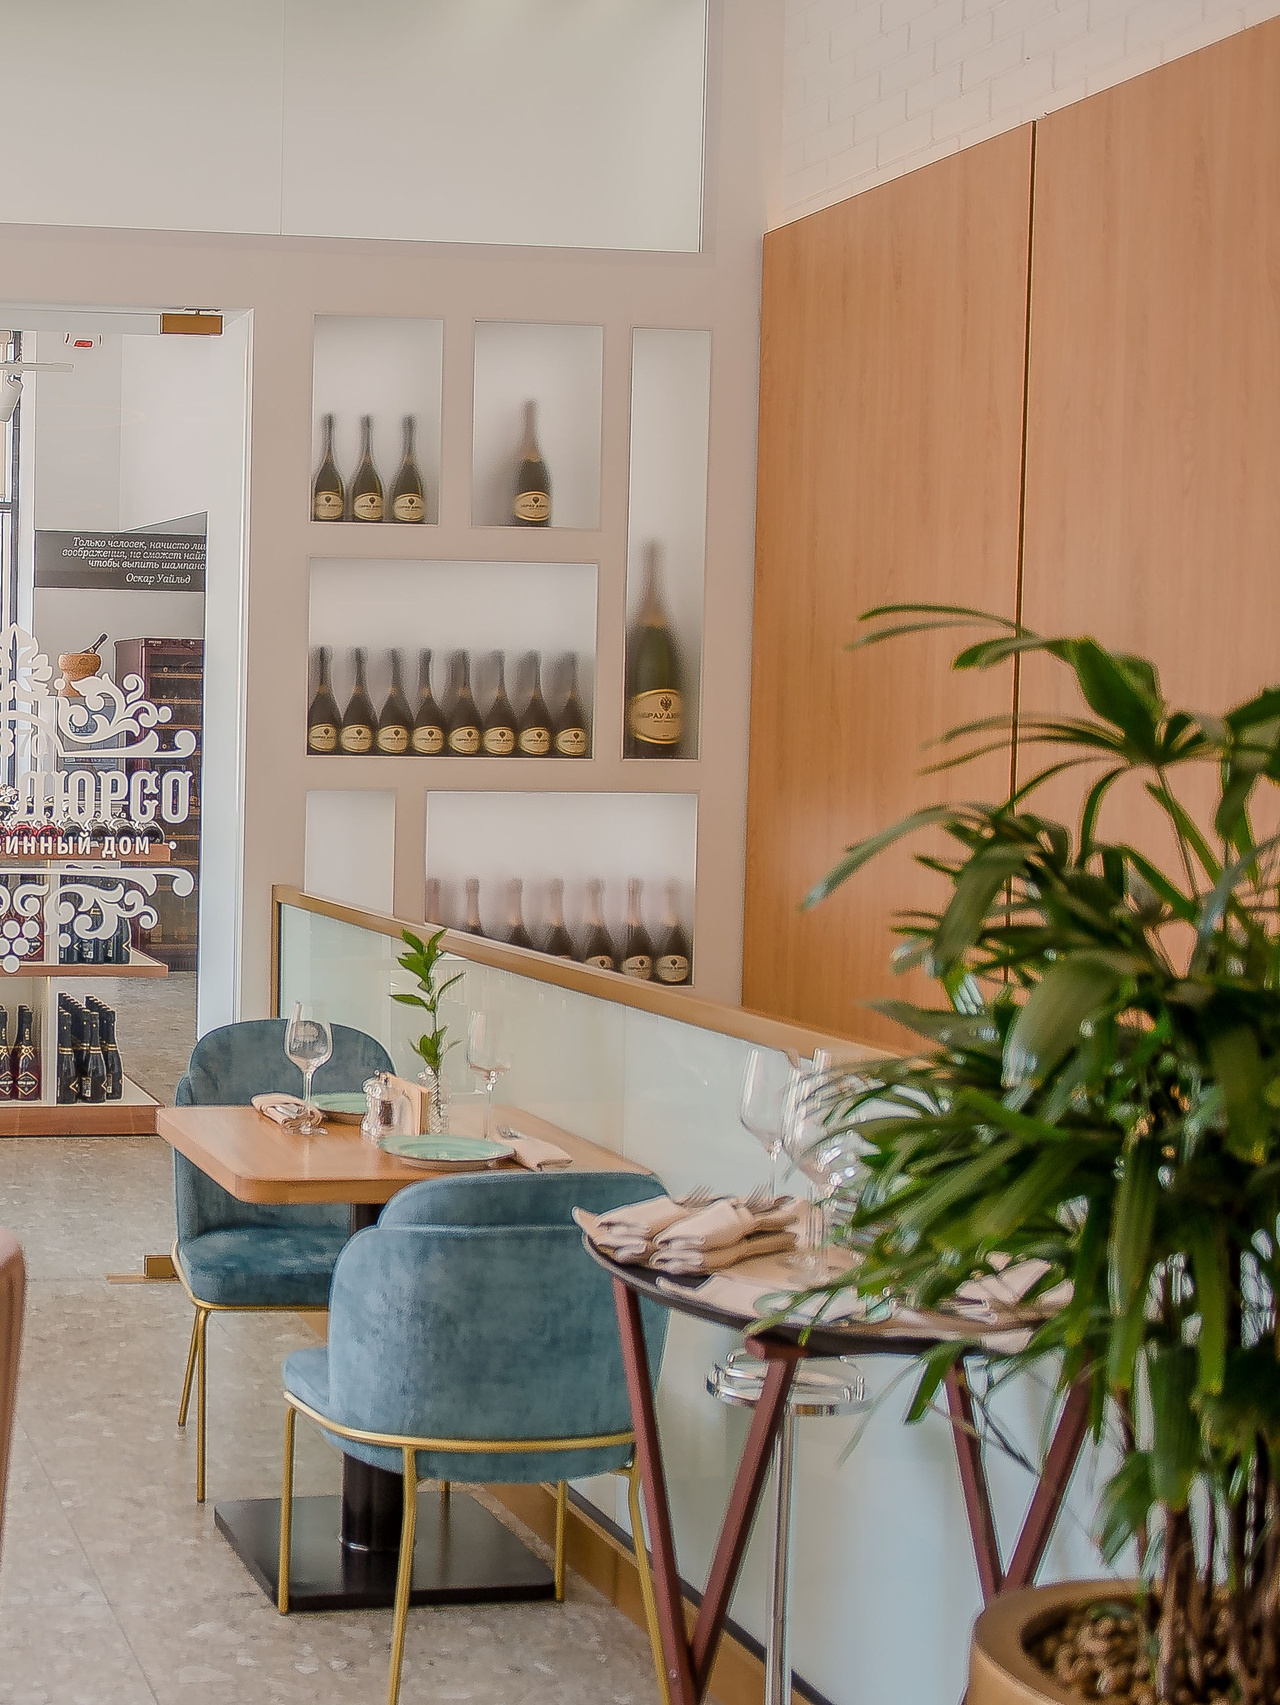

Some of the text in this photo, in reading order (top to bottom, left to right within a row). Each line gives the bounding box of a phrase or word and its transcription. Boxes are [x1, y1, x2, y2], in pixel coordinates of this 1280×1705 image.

[72, 536, 106, 548] Только
[107, 539, 148, 550] человек,
[149, 541, 189, 550] начисто
[61, 549, 128, 559] воображения,
[130, 551, 142, 559] не
[143, 551, 182, 560] сможет
[88, 558, 120, 568] чтобы
[122, 561, 159, 569] выпить
[125, 573, 191, 585] Оскар Уайльд
[13, 769, 193, 825] ДЮРСО
[101, 835, 151, 858] ДОМ
